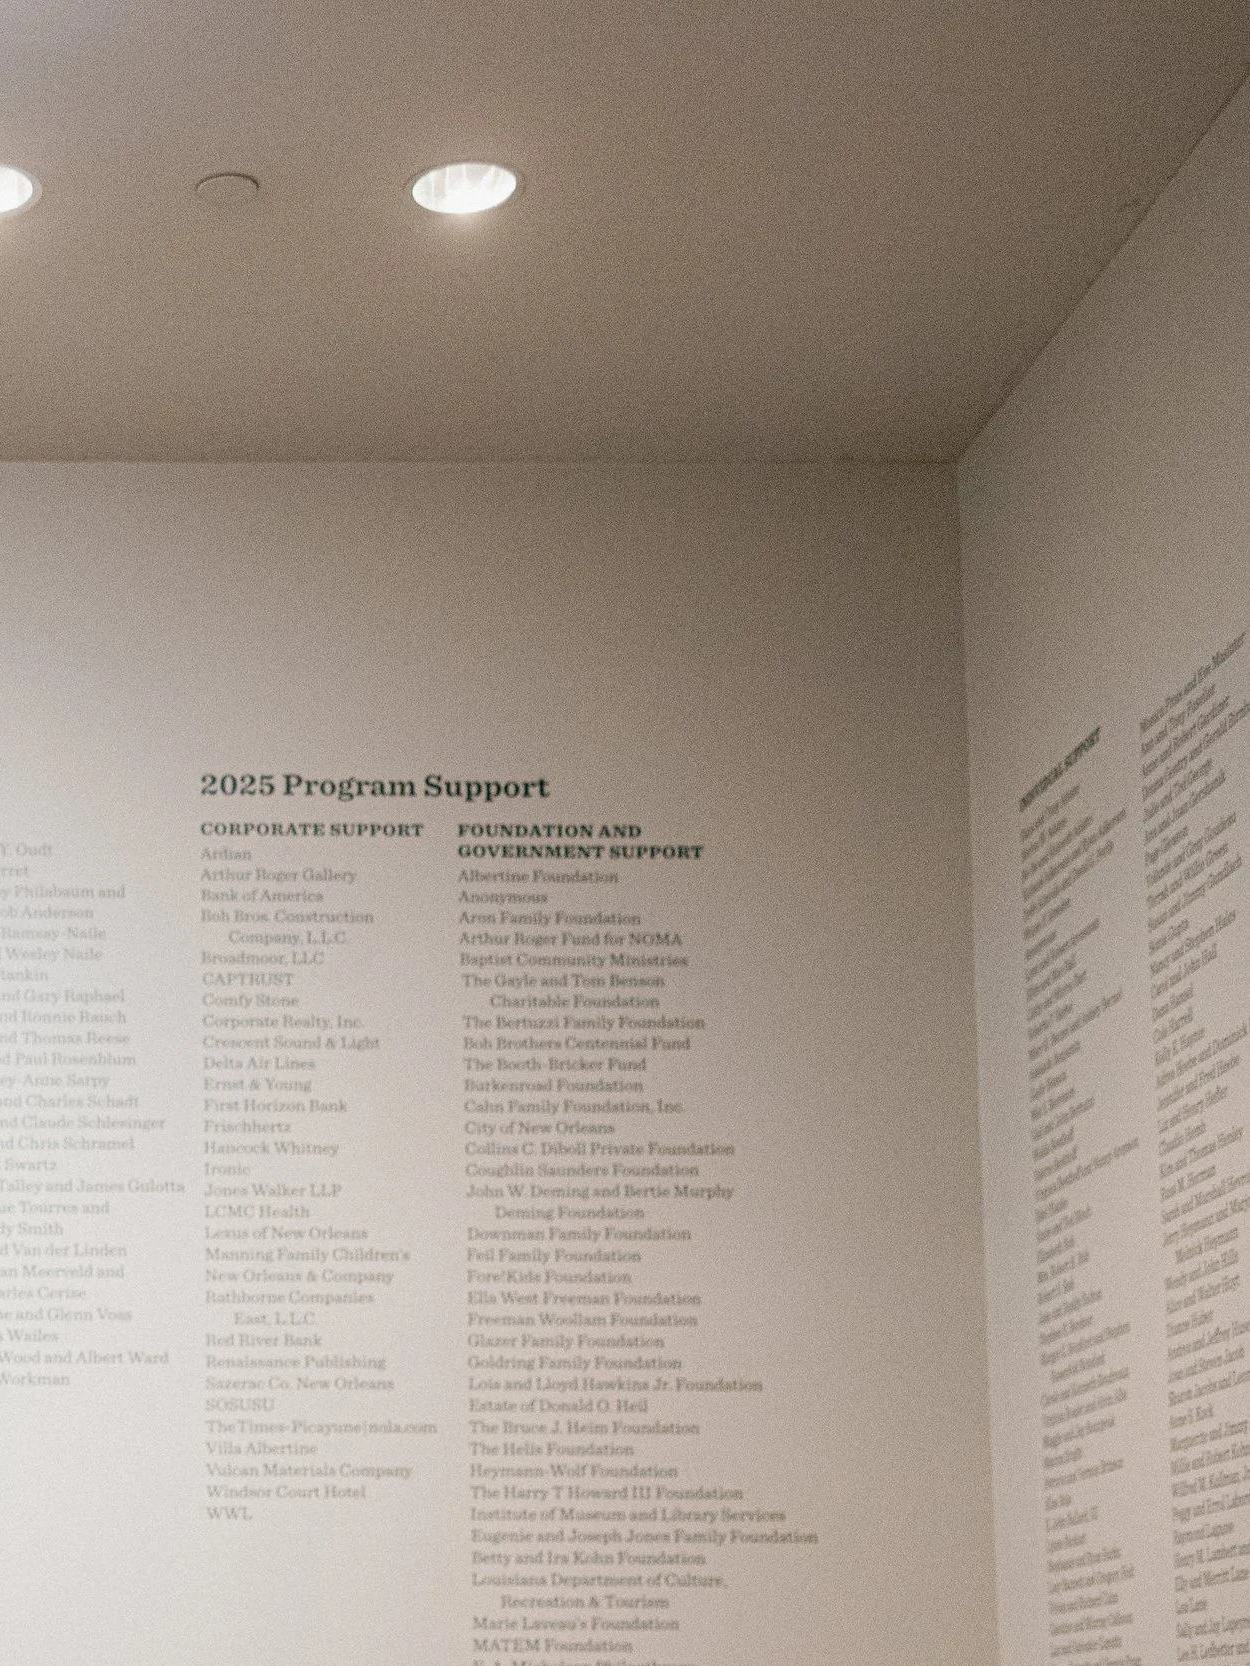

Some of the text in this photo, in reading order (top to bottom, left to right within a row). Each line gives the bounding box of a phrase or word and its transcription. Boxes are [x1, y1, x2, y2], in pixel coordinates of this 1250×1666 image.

[200, 774, 550, 803] 2025 Program Support
[199, 823, 424, 837] CORPORATE SUPPORT
[457, 825, 642, 838] FOUNDATION AND
[457, 846, 704, 860] GOVERNMENT SUPPORT
[457, 870, 620, 883] Albertine Foundation
[200, 890, 239, 902] Bank
[260, 890, 324, 902] America
[457, 891, 549, 908] Anonymous
[458, 912, 642, 929] Aron Family Foundation
[202, 1057, 317, 1070] Delta Air Lines
[463, 1121, 497, 1138] City
[517, 1121, 552, 1134] New
[555, 1121, 616, 1134] Orleans
[472, 1640, 633, 1653] MATEM Foundation
